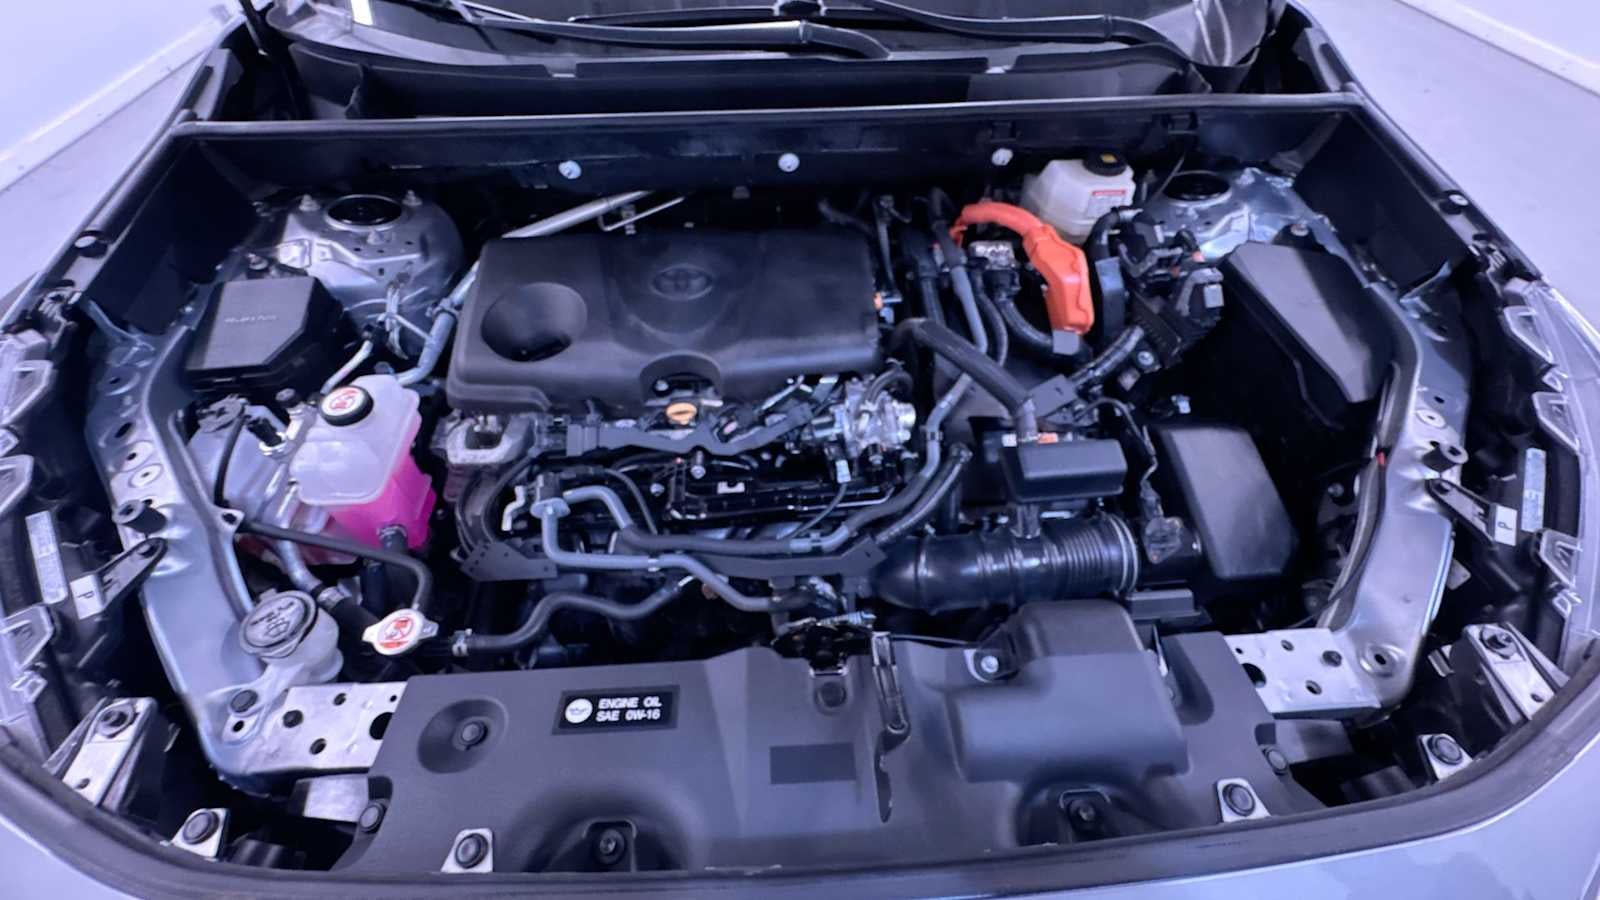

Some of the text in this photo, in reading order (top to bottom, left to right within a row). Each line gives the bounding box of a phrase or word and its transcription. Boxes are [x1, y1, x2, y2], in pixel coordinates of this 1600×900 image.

[598, 696, 662, 709] ENGINE OIL
[595, 709, 661, 722] SAE 0W-16
